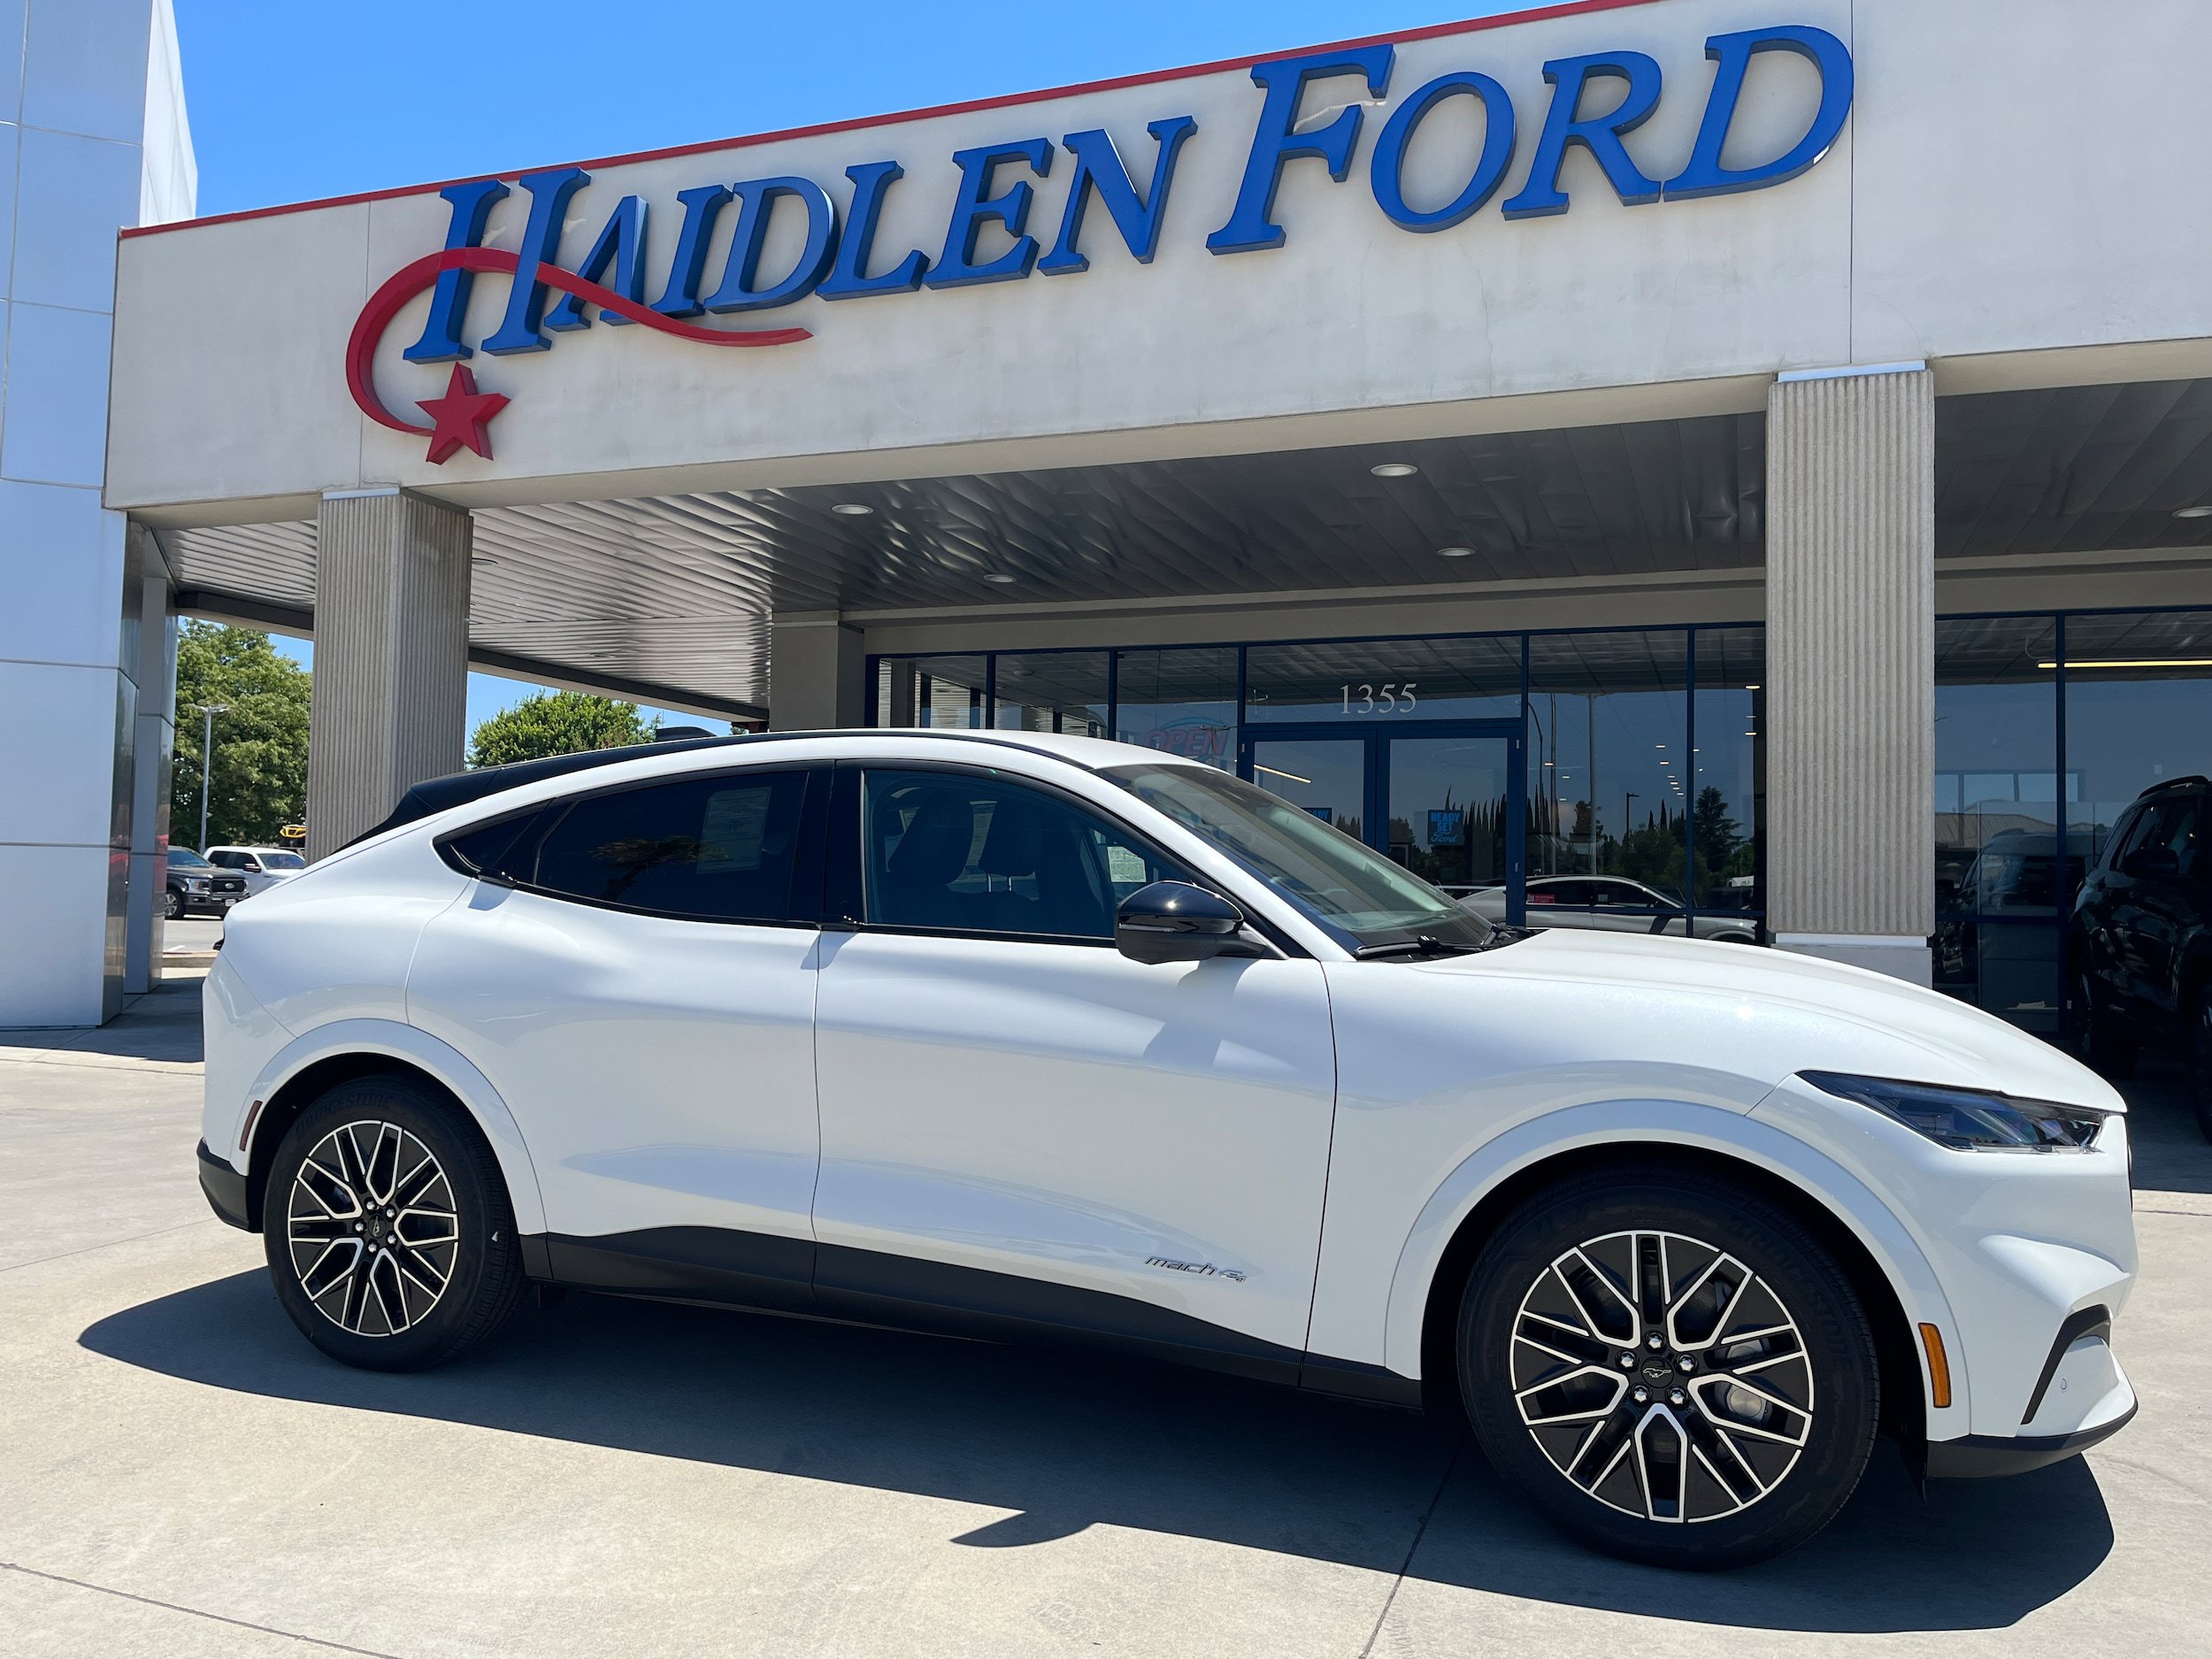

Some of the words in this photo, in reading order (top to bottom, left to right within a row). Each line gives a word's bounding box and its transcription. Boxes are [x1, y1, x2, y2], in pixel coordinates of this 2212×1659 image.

[403, 115, 1197, 365] HAIDLEN
[1206, 25, 1855, 256] FORD
[1340, 682, 1417, 714] 1355
[1146, 728, 1230, 757] OPEN
[1431, 812, 1460, 823] READY
[1436, 822, 1454, 832] SET
[1430, 832, 1458, 843] Ford
